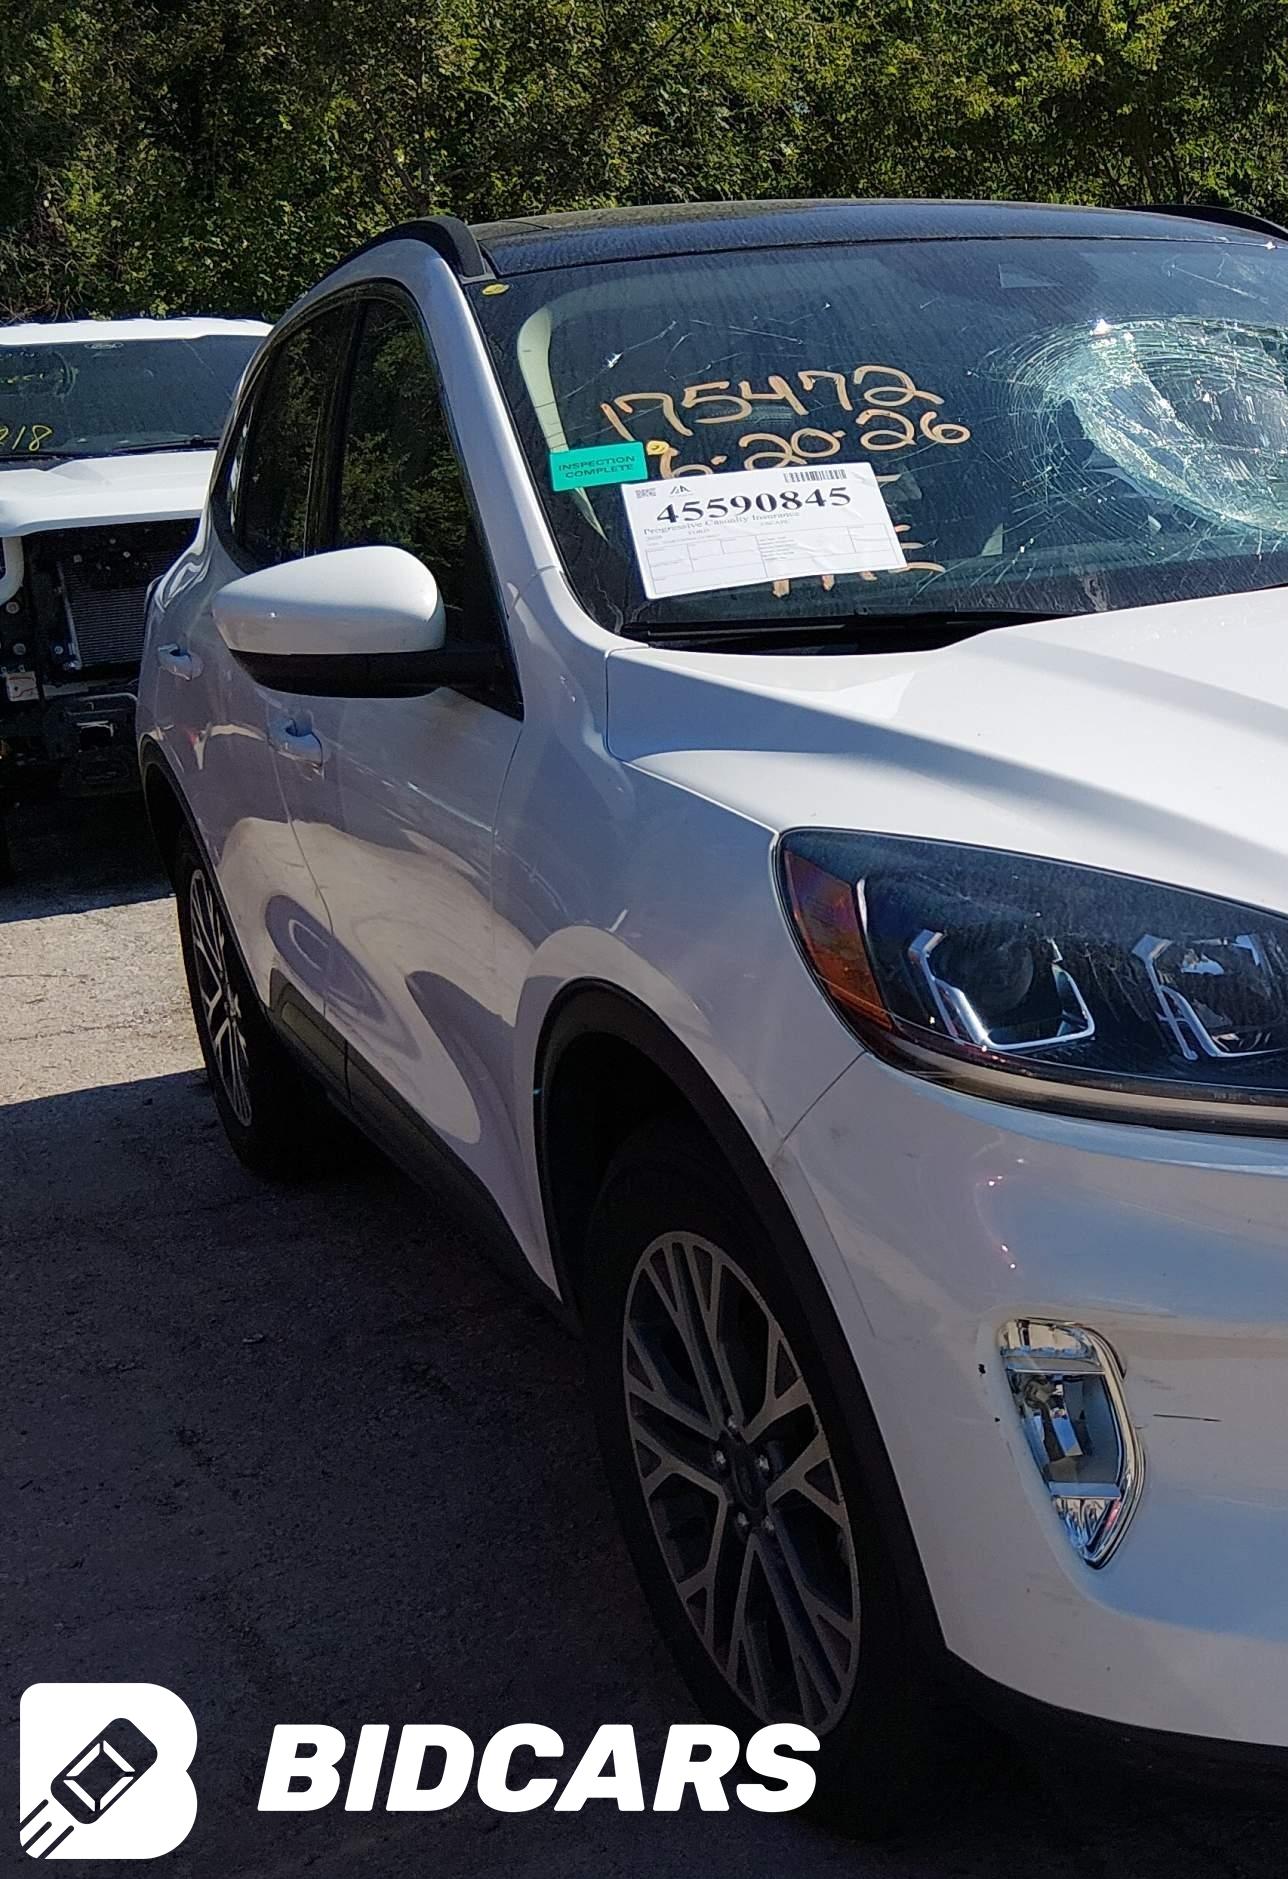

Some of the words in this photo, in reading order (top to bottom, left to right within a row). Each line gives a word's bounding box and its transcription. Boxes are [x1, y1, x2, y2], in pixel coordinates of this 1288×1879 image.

[600, 364, 945, 440] 175472
[558, 455, 636, 471] INSPECTION
[565, 463, 634, 478] COMPLETE
[656, 486, 852, 524] 45590845
[643, 520, 703, 535] Progressive
[704, 515, 749, 527] Casualty
[752, 511, 800, 521] Insurance
